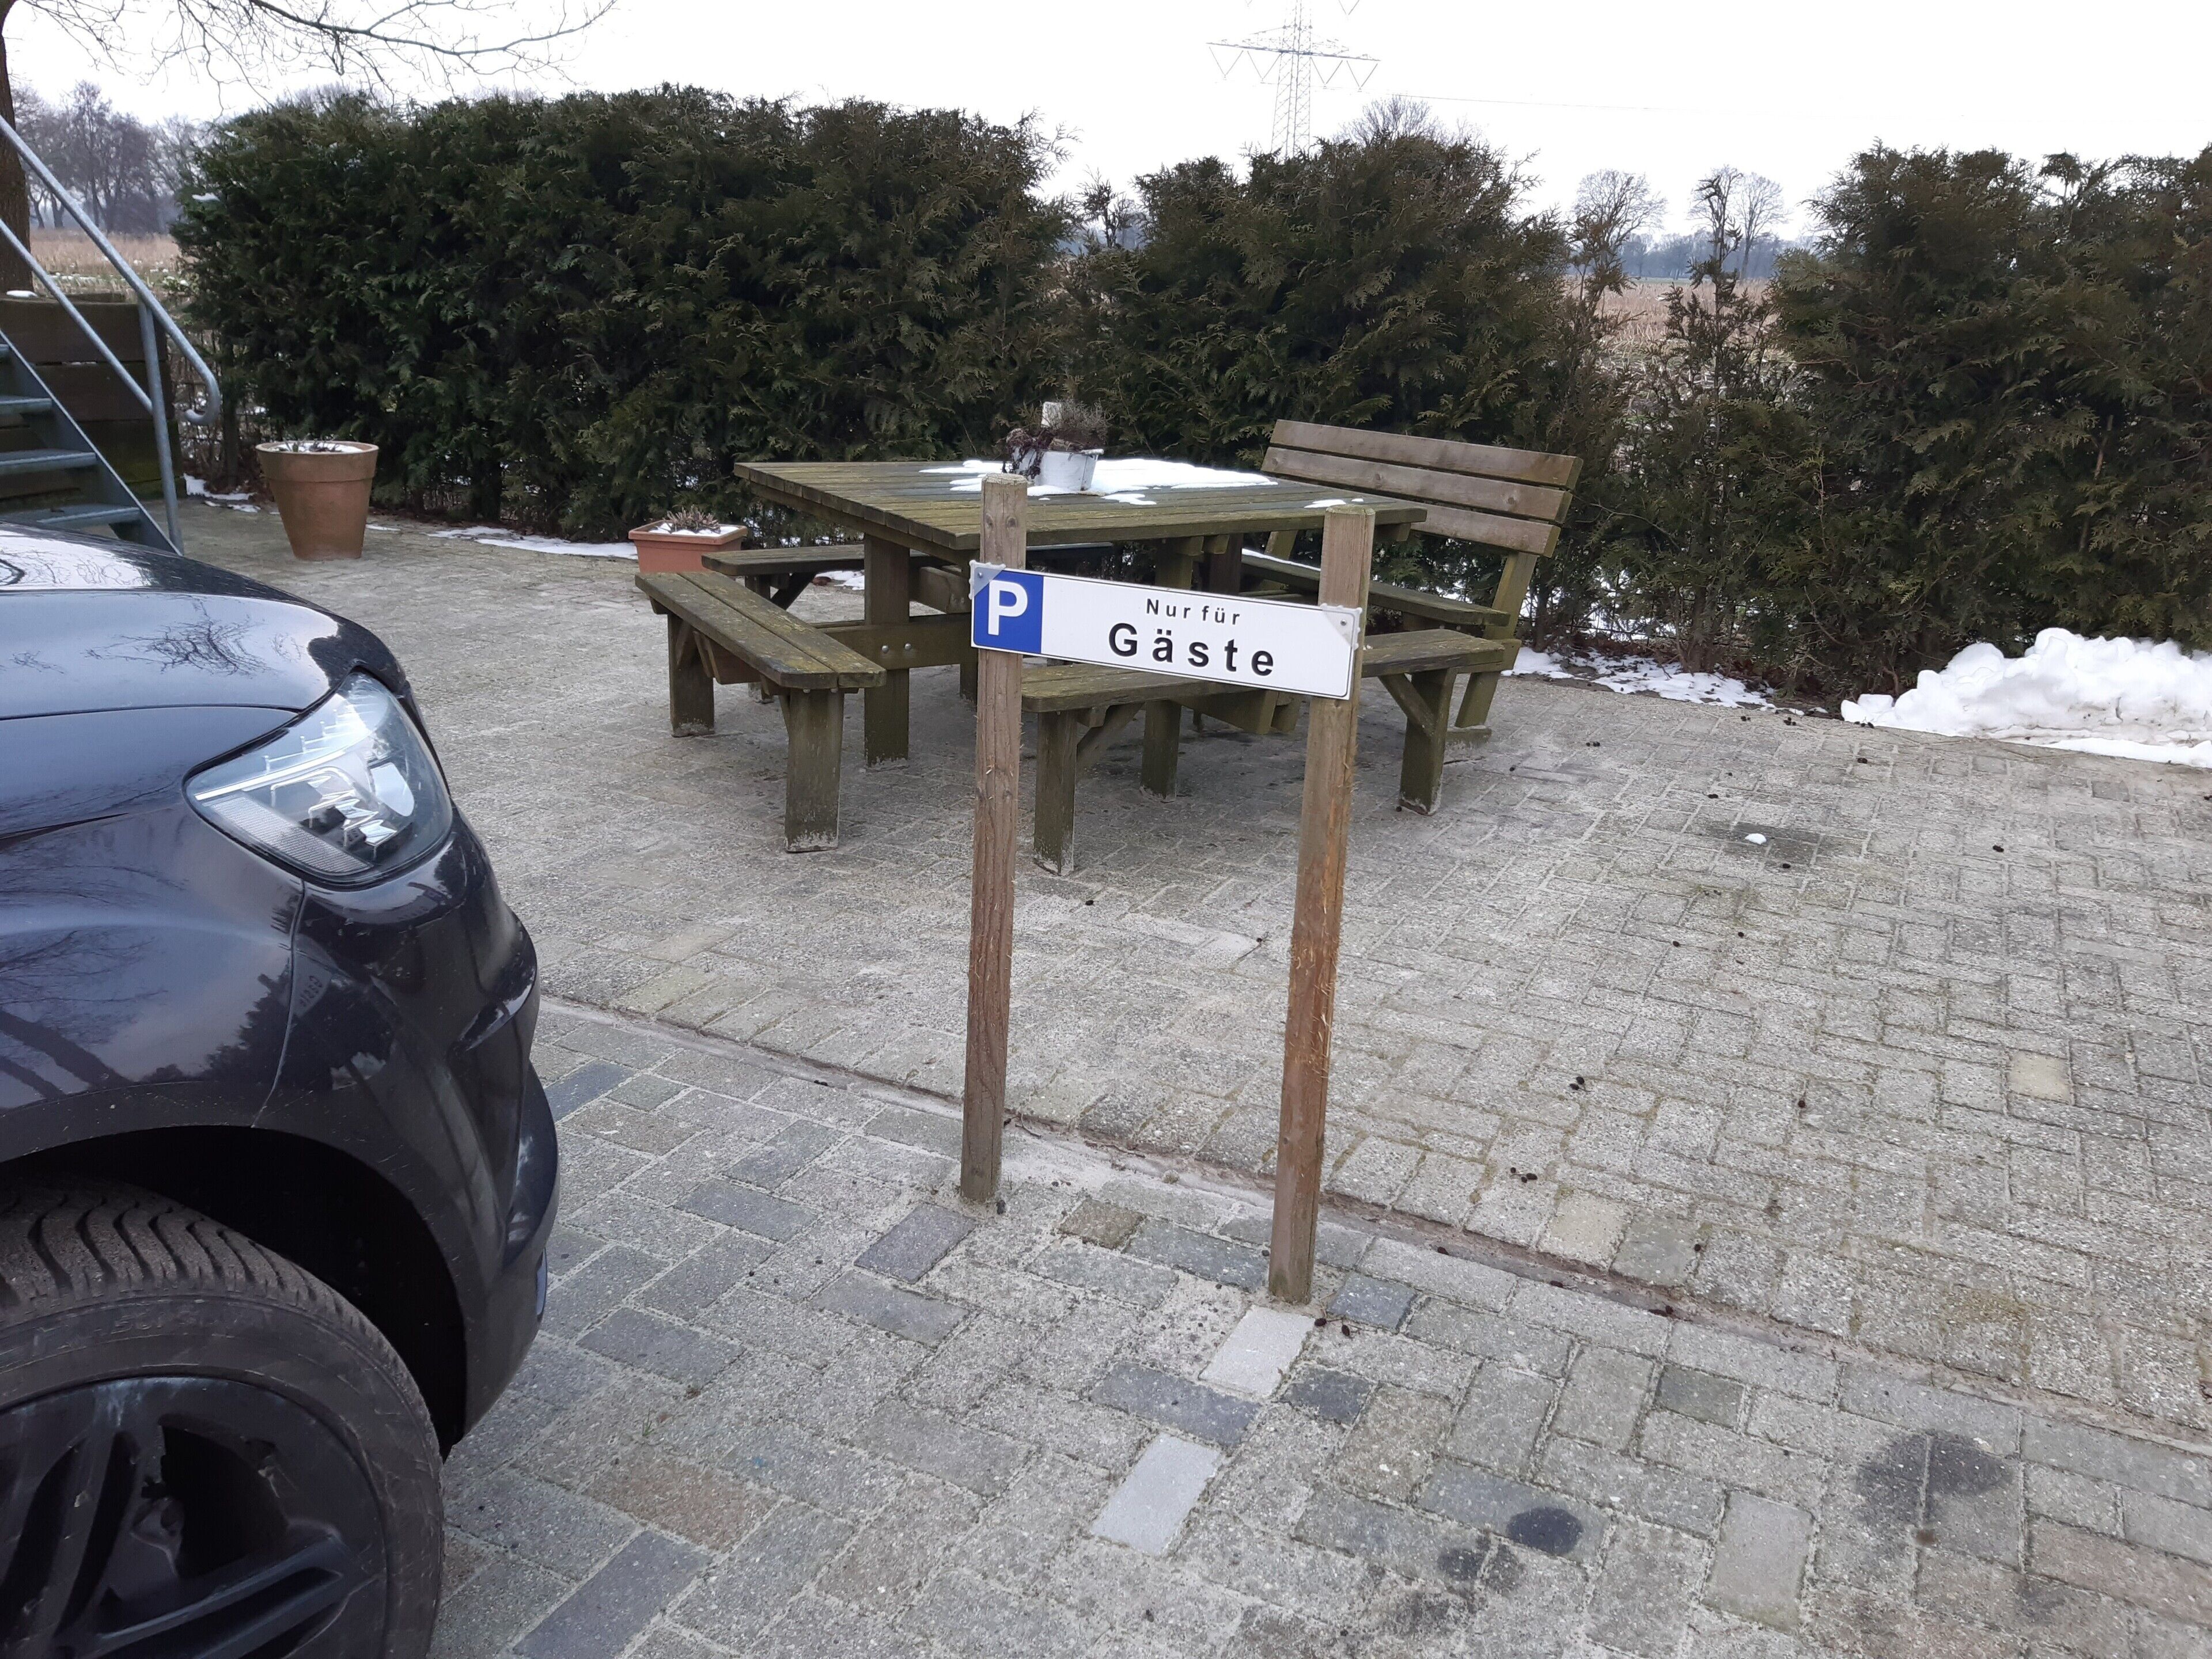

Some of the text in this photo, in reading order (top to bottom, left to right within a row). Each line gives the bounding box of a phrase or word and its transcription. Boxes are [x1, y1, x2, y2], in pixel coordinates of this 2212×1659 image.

[988, 580, 1028, 636] P
[1146, 598, 1240, 625] Nur für
[1108, 622, 1274, 676] Gäste
